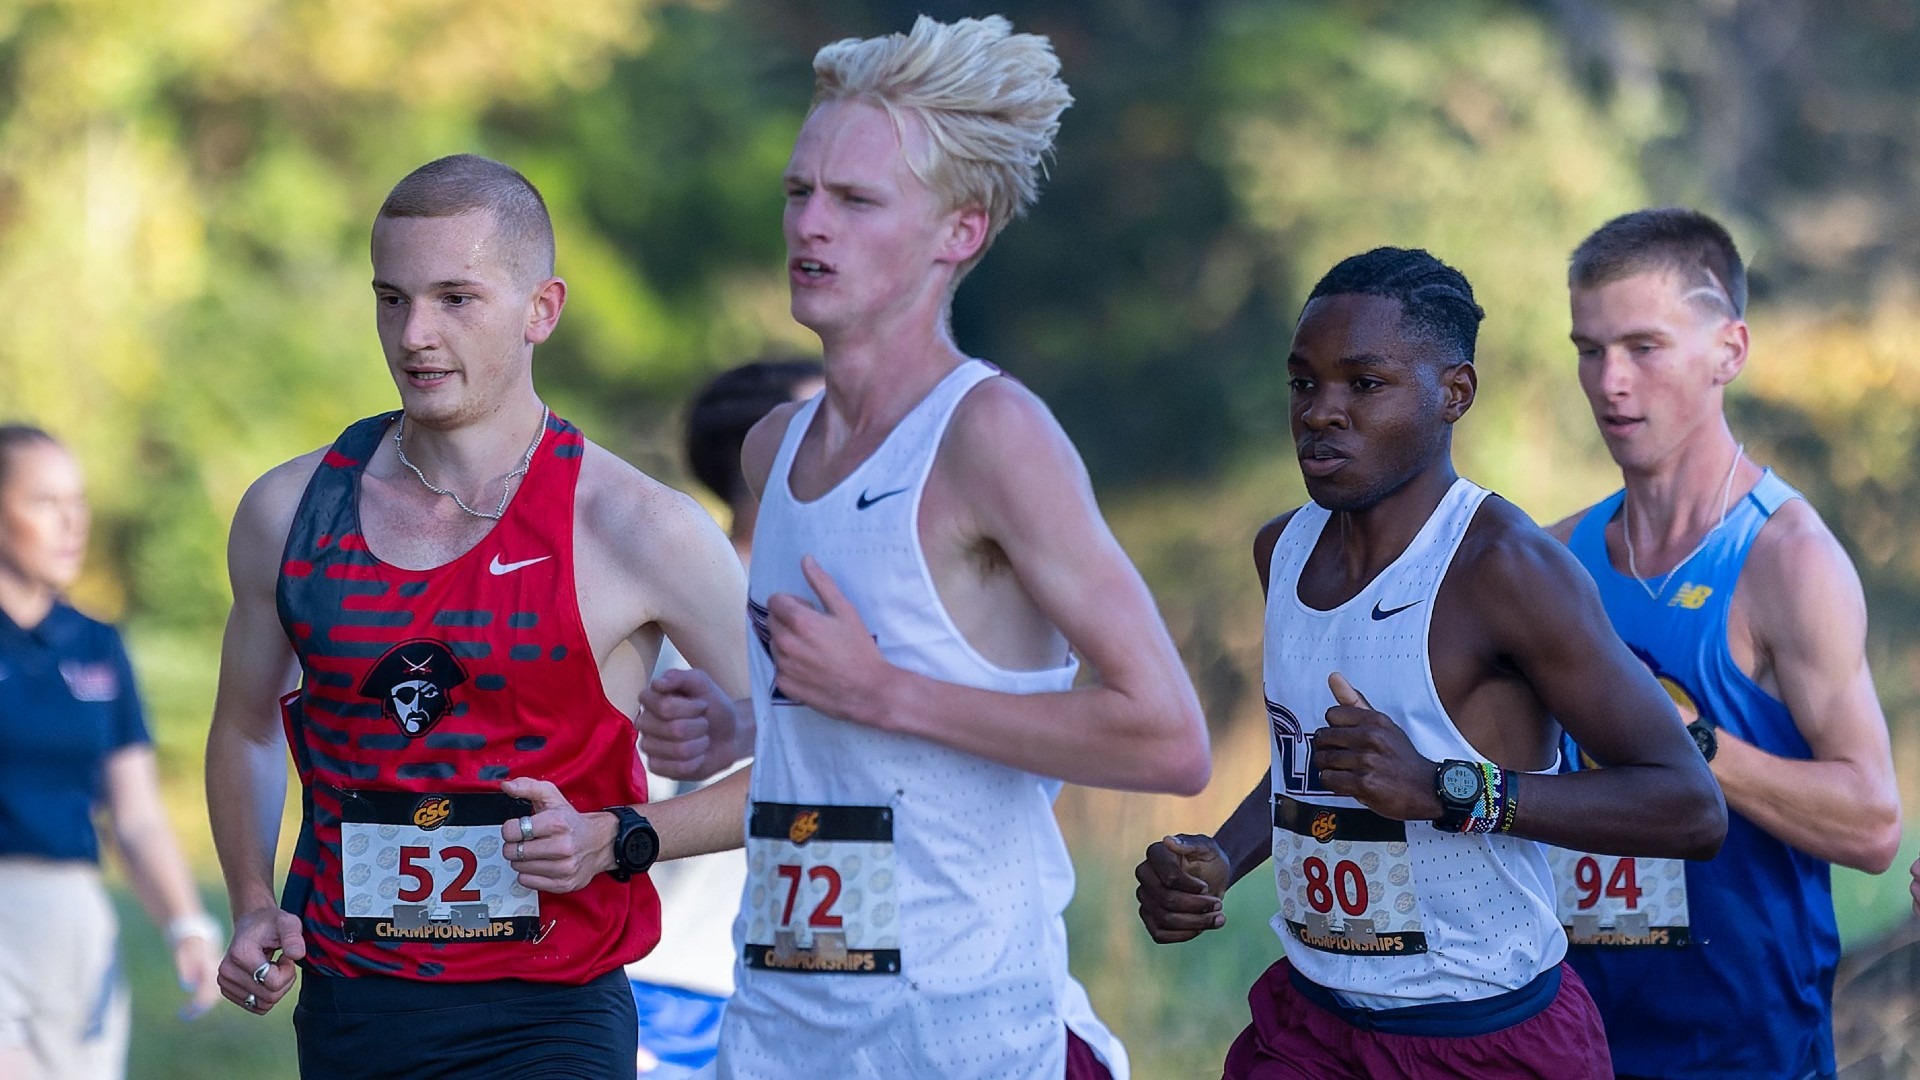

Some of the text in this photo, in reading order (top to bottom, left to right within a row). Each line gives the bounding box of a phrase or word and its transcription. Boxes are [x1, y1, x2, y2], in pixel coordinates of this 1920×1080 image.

[413, 799, 450, 826] GSC
[1311, 813, 1337, 838] GSC
[397, 845, 481, 903] 52
[777, 864, 843, 928] 72
[1303, 856, 1369, 917] 80
[1574, 855, 1642, 910] 94
[375, 921, 515, 939] CHAMPIONSHIPS
